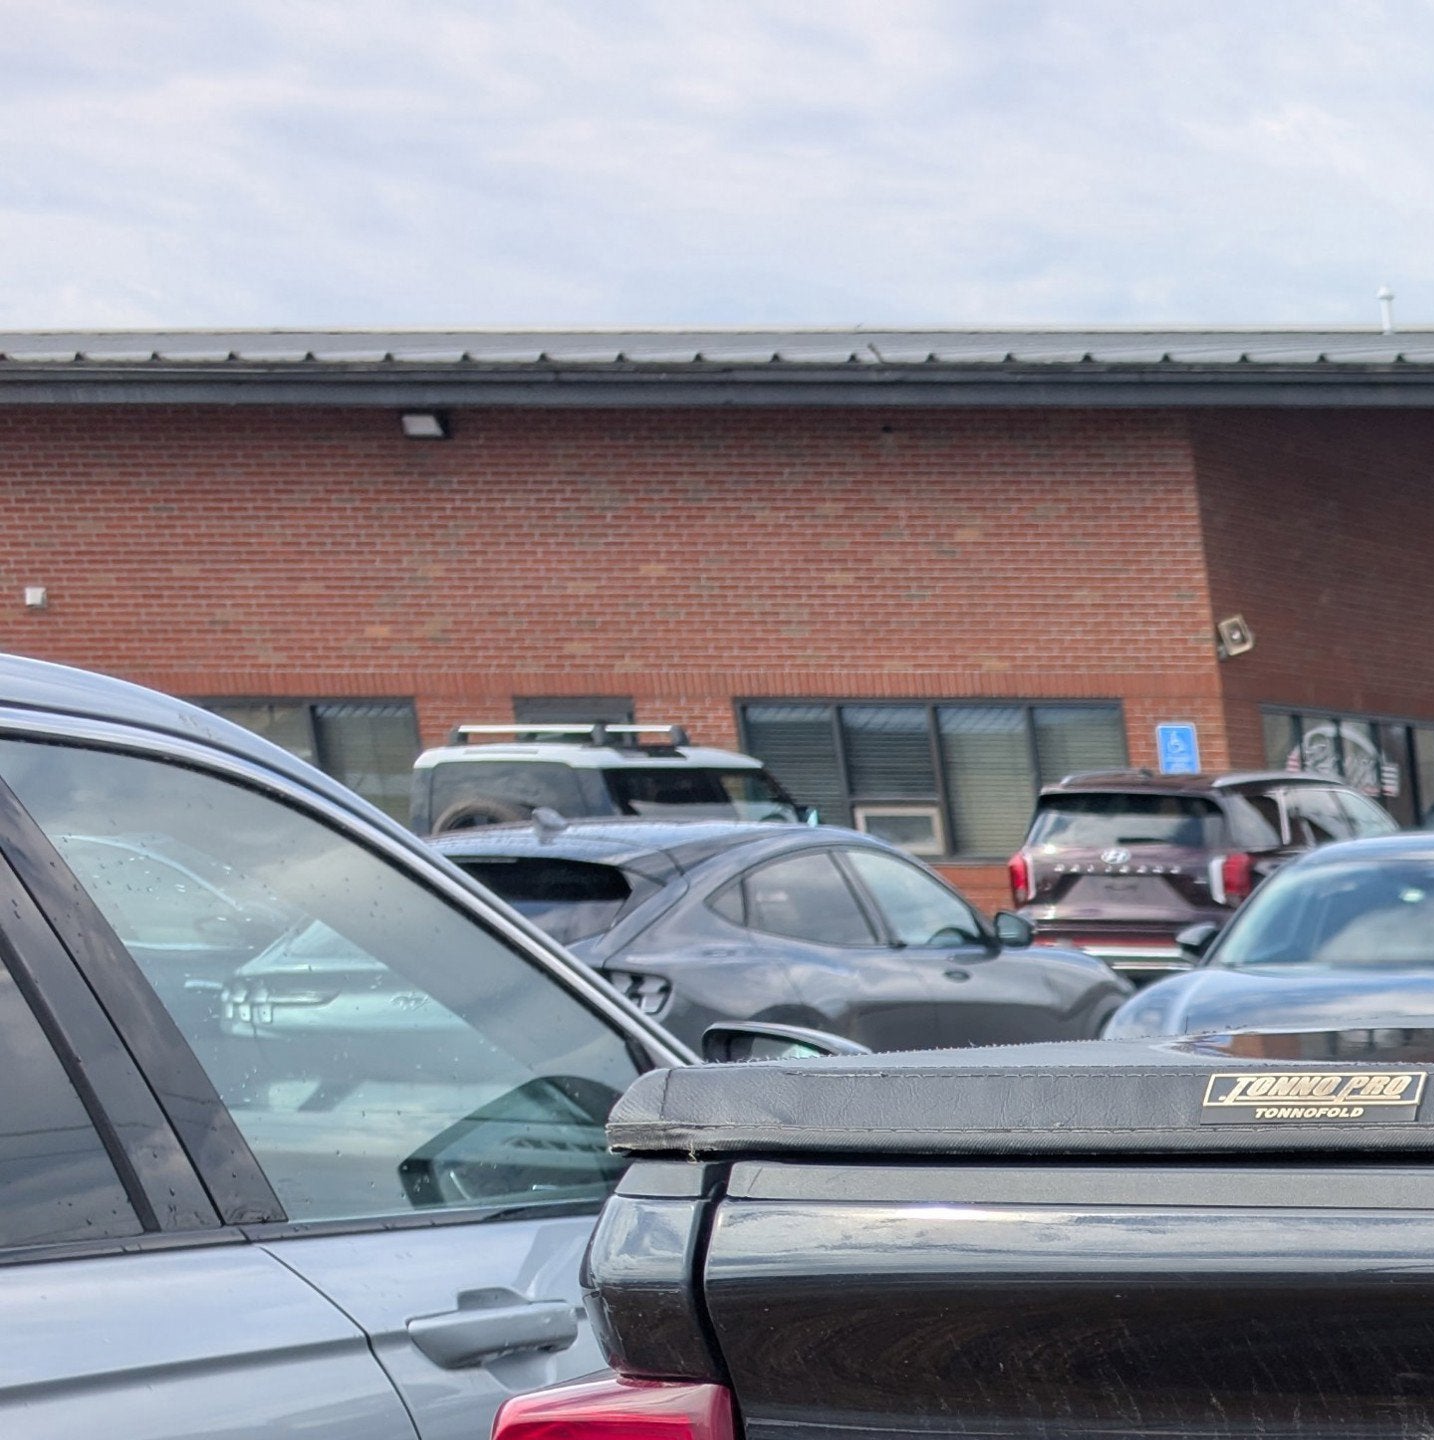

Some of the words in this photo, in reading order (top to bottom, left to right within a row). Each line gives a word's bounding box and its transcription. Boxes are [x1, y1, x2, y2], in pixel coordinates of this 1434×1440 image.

[1219, 1076, 1342, 1104] TONNO
[1334, 1075, 1412, 1104] PRO
[1255, 1107, 1364, 1119] TONNOFOLD
